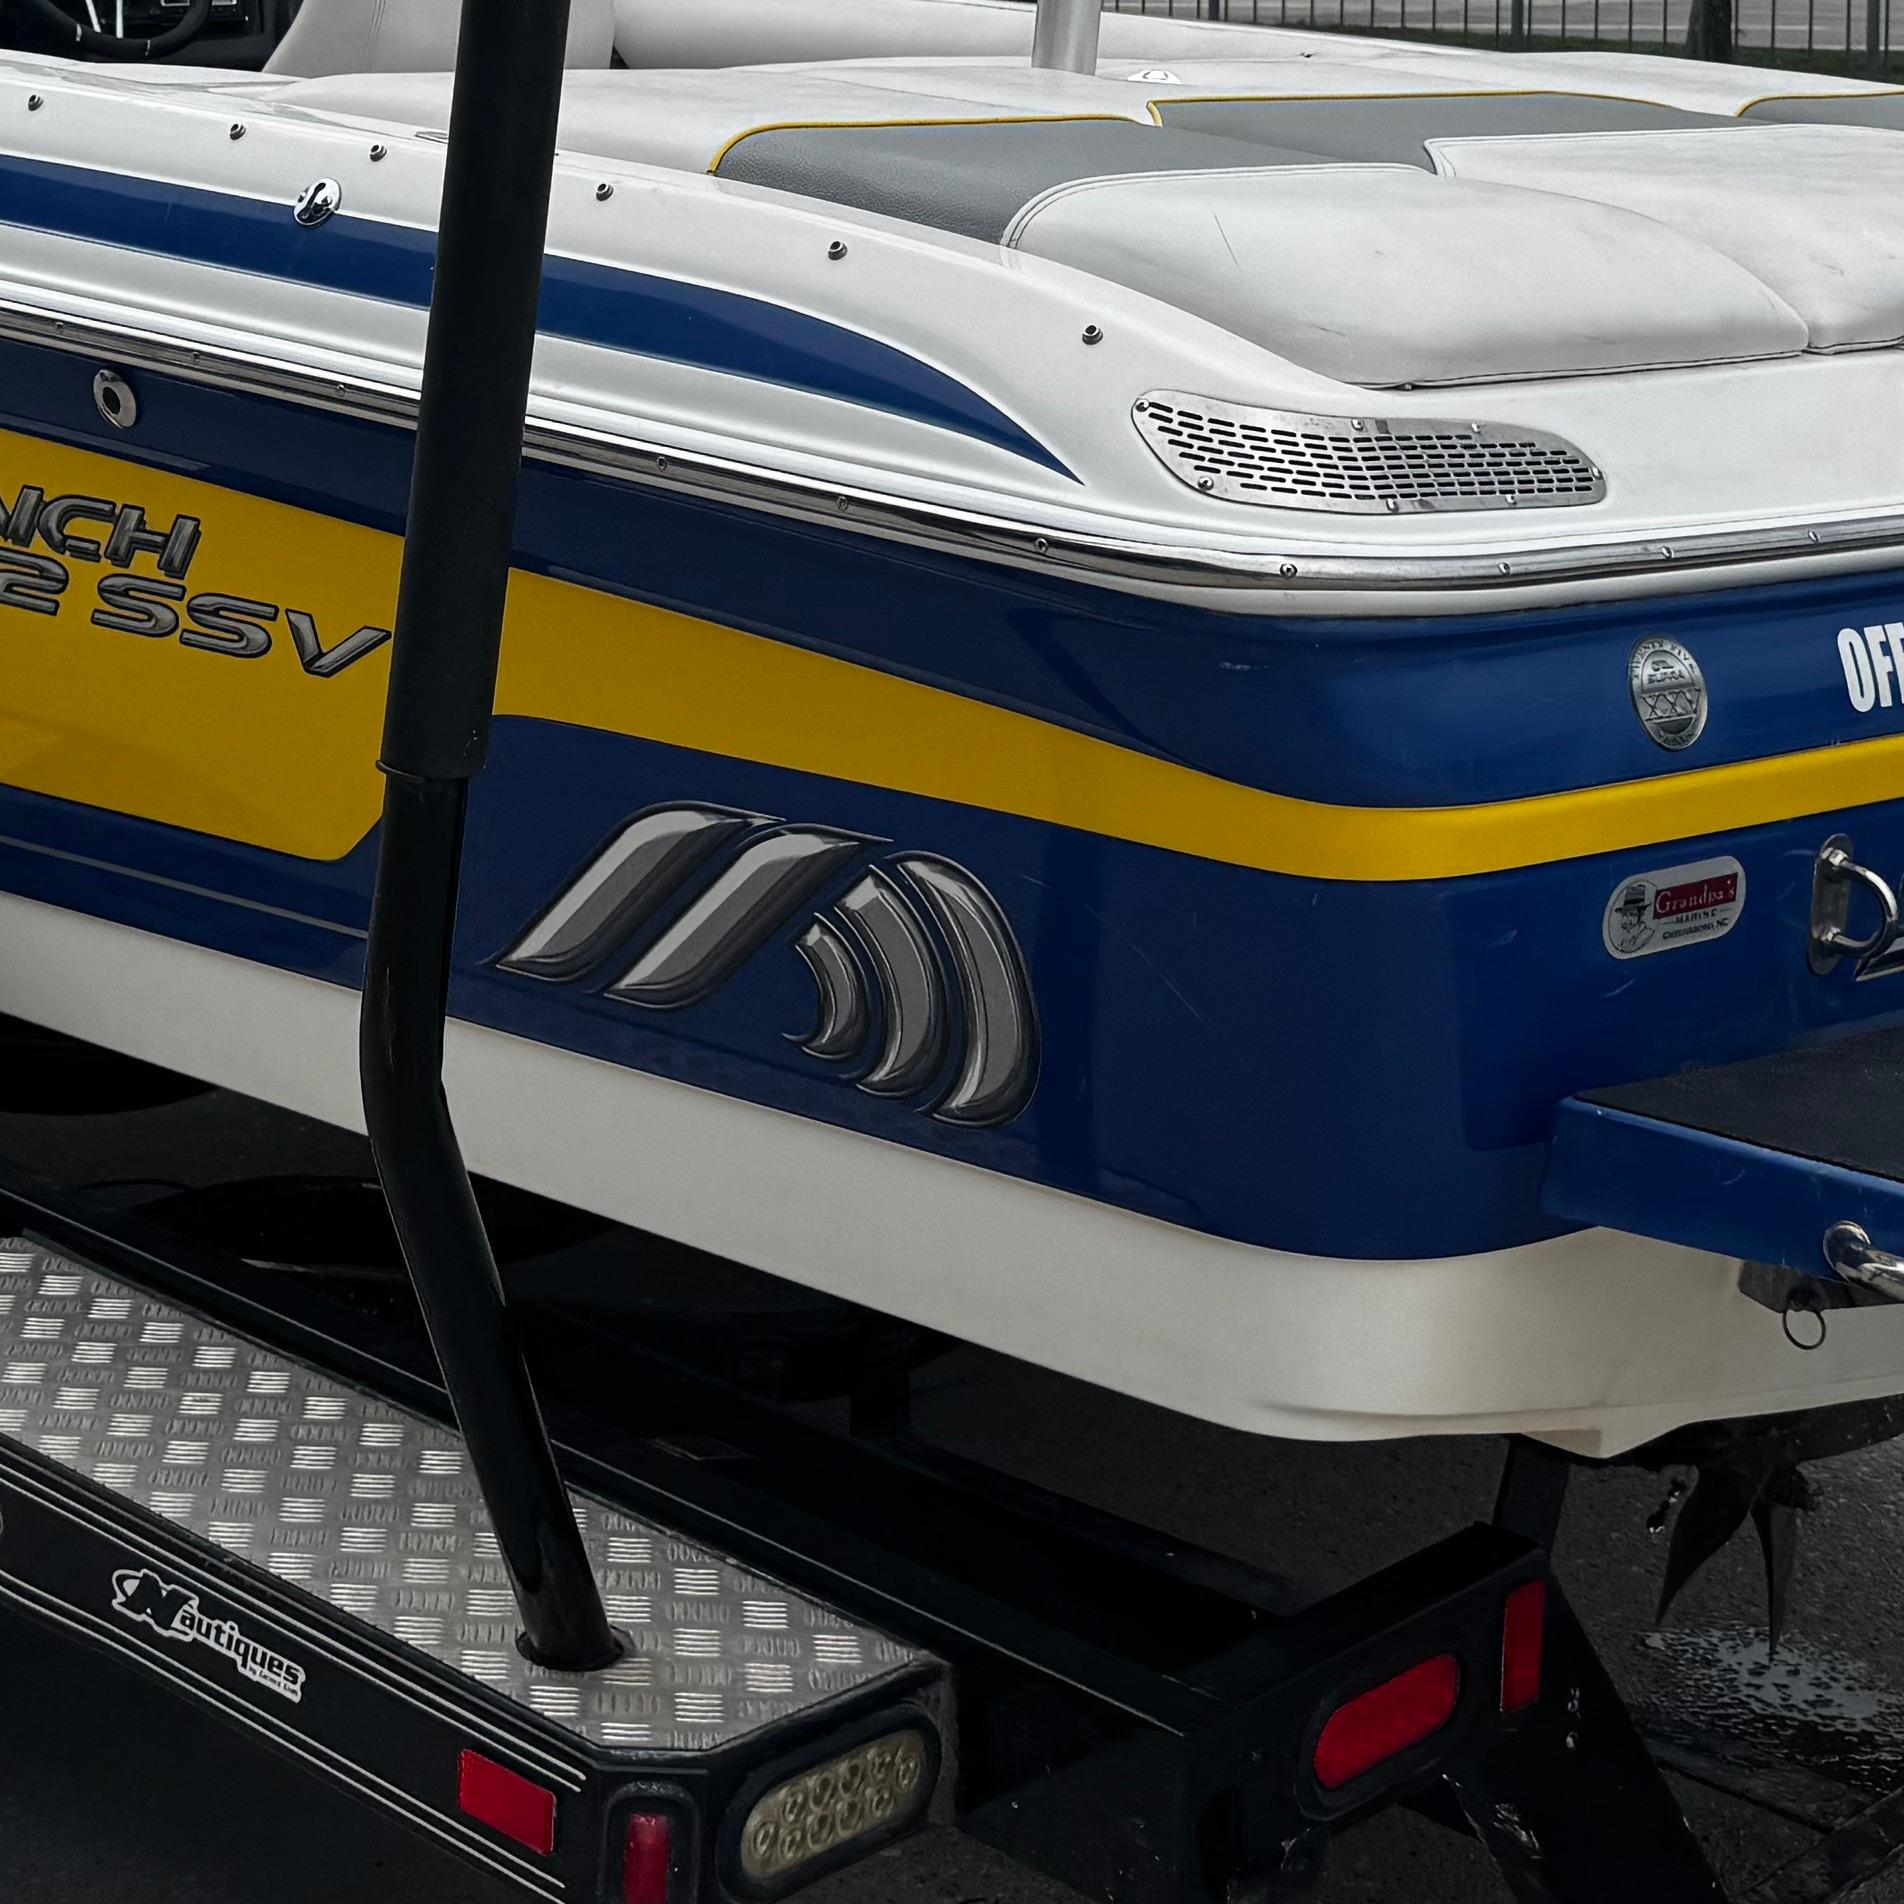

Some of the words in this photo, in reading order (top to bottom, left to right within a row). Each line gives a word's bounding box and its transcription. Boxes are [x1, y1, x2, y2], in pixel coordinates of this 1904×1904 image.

[90, 572, 392, 678] SSV
[1656, 880, 1734, 913] Grandpa's
[114, 1571, 302, 1686] Nautiques
